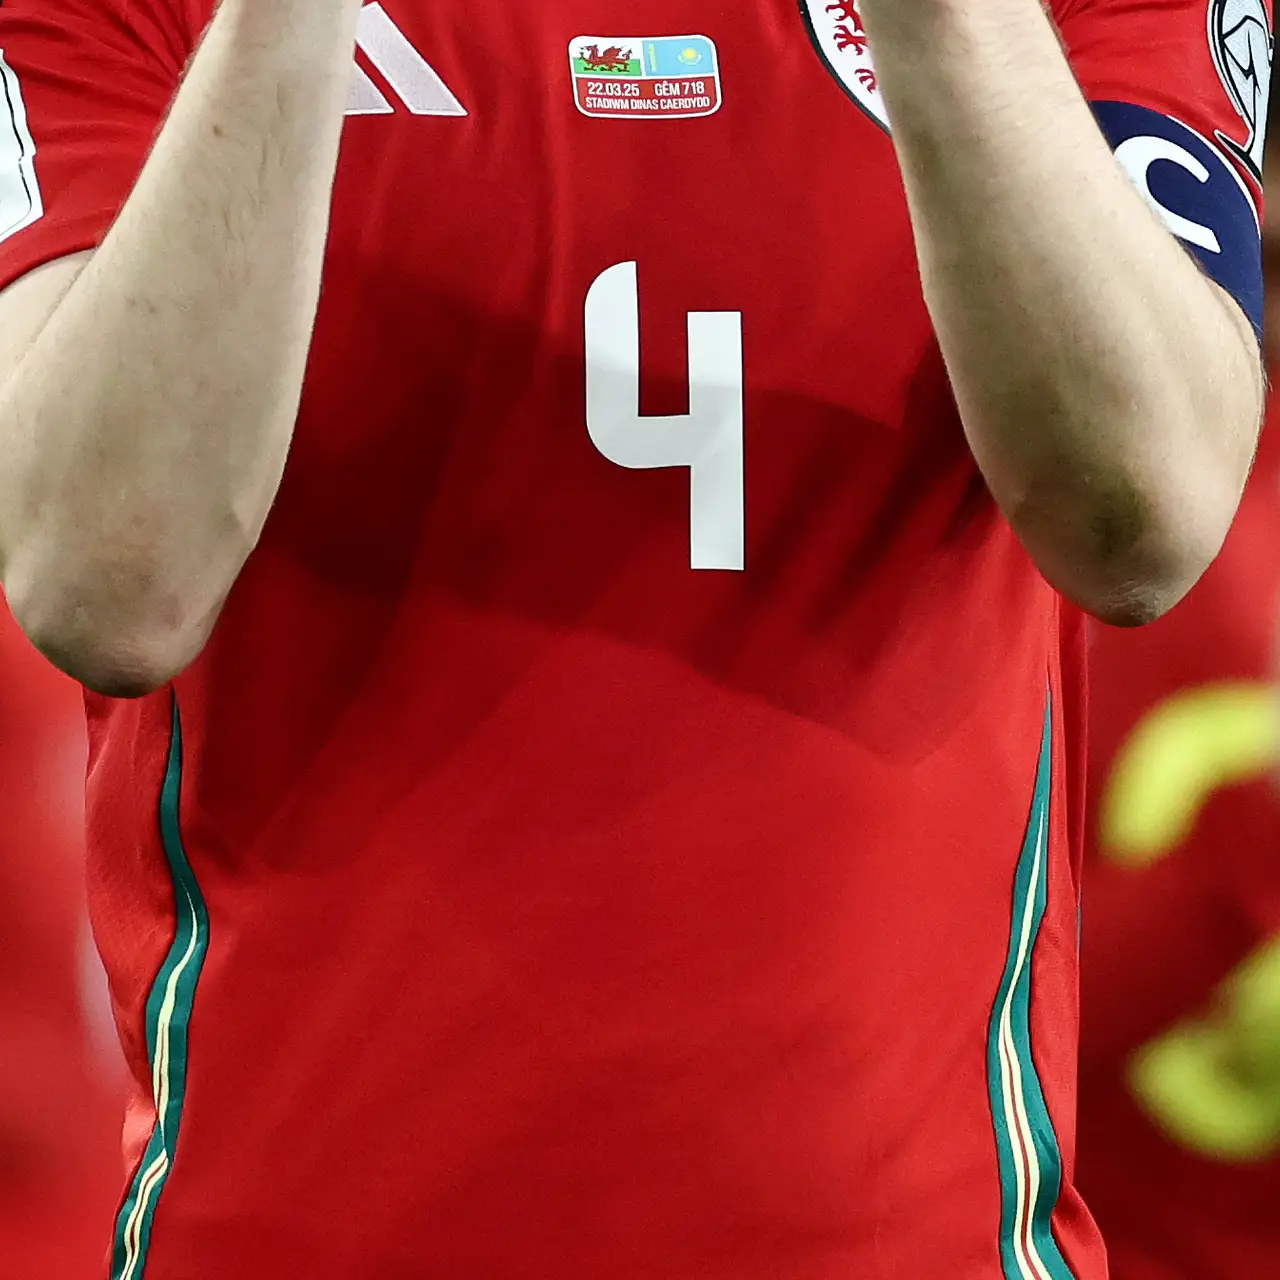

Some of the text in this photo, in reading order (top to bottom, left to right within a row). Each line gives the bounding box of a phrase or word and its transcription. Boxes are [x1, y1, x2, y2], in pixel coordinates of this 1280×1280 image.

[586, 96, 710, 110] STADIWM DINAS CAERDYDD
[587, 80, 705, 96] 22.03.25 GÊM 718
[1114, 135, 1222, 254] C
[584, 260, 745, 571] 4
